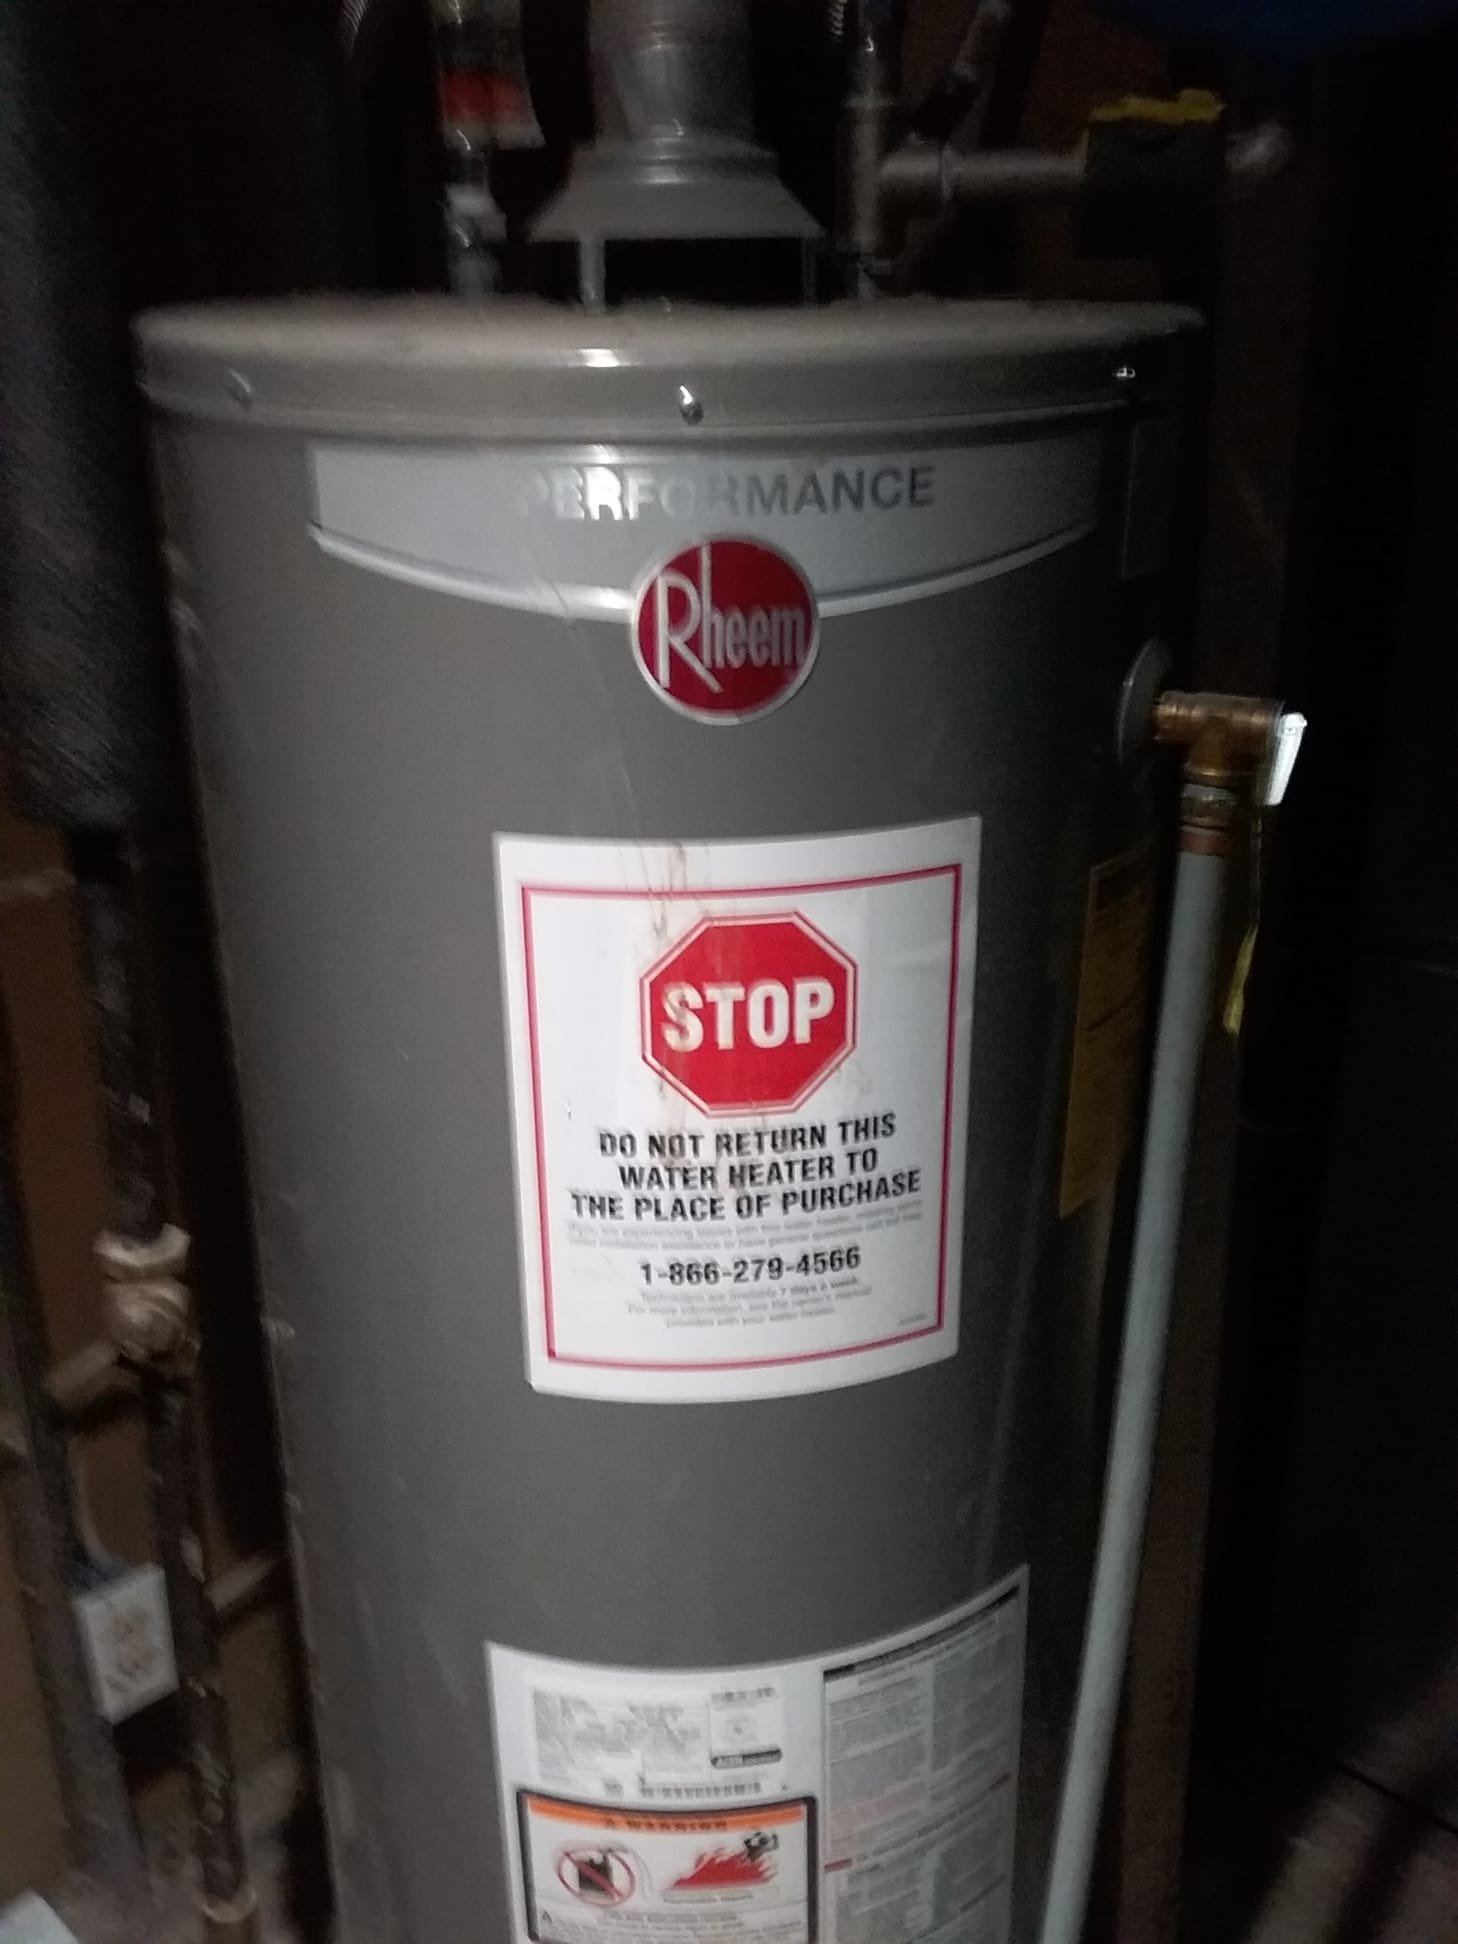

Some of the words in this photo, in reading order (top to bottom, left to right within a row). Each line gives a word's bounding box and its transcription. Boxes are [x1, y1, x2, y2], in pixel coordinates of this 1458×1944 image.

[519, 464, 936, 520] PERFORMANCE
[656, 543, 806, 693] Rheem
[661, 975, 836, 1052] STOP
[599, 1131, 637, 1158] DO
[648, 1132, 704, 1159] NOT
[715, 1123, 826, 1158] RETURN
[838, 1111, 897, 1145] THIS
[571, 1193, 624, 1220] THE
[634, 1197, 726, 1223] PLACE
[736, 1193, 770, 1219] OF
[782, 1168, 922, 1217] PURCHASE
[618, 1164, 717, 1191] WATER
[728, 1154, 834, 1189] HEATER
[847, 1147, 878, 1176] TO
[640, 1245, 861, 1286] 1-866-279-4566
